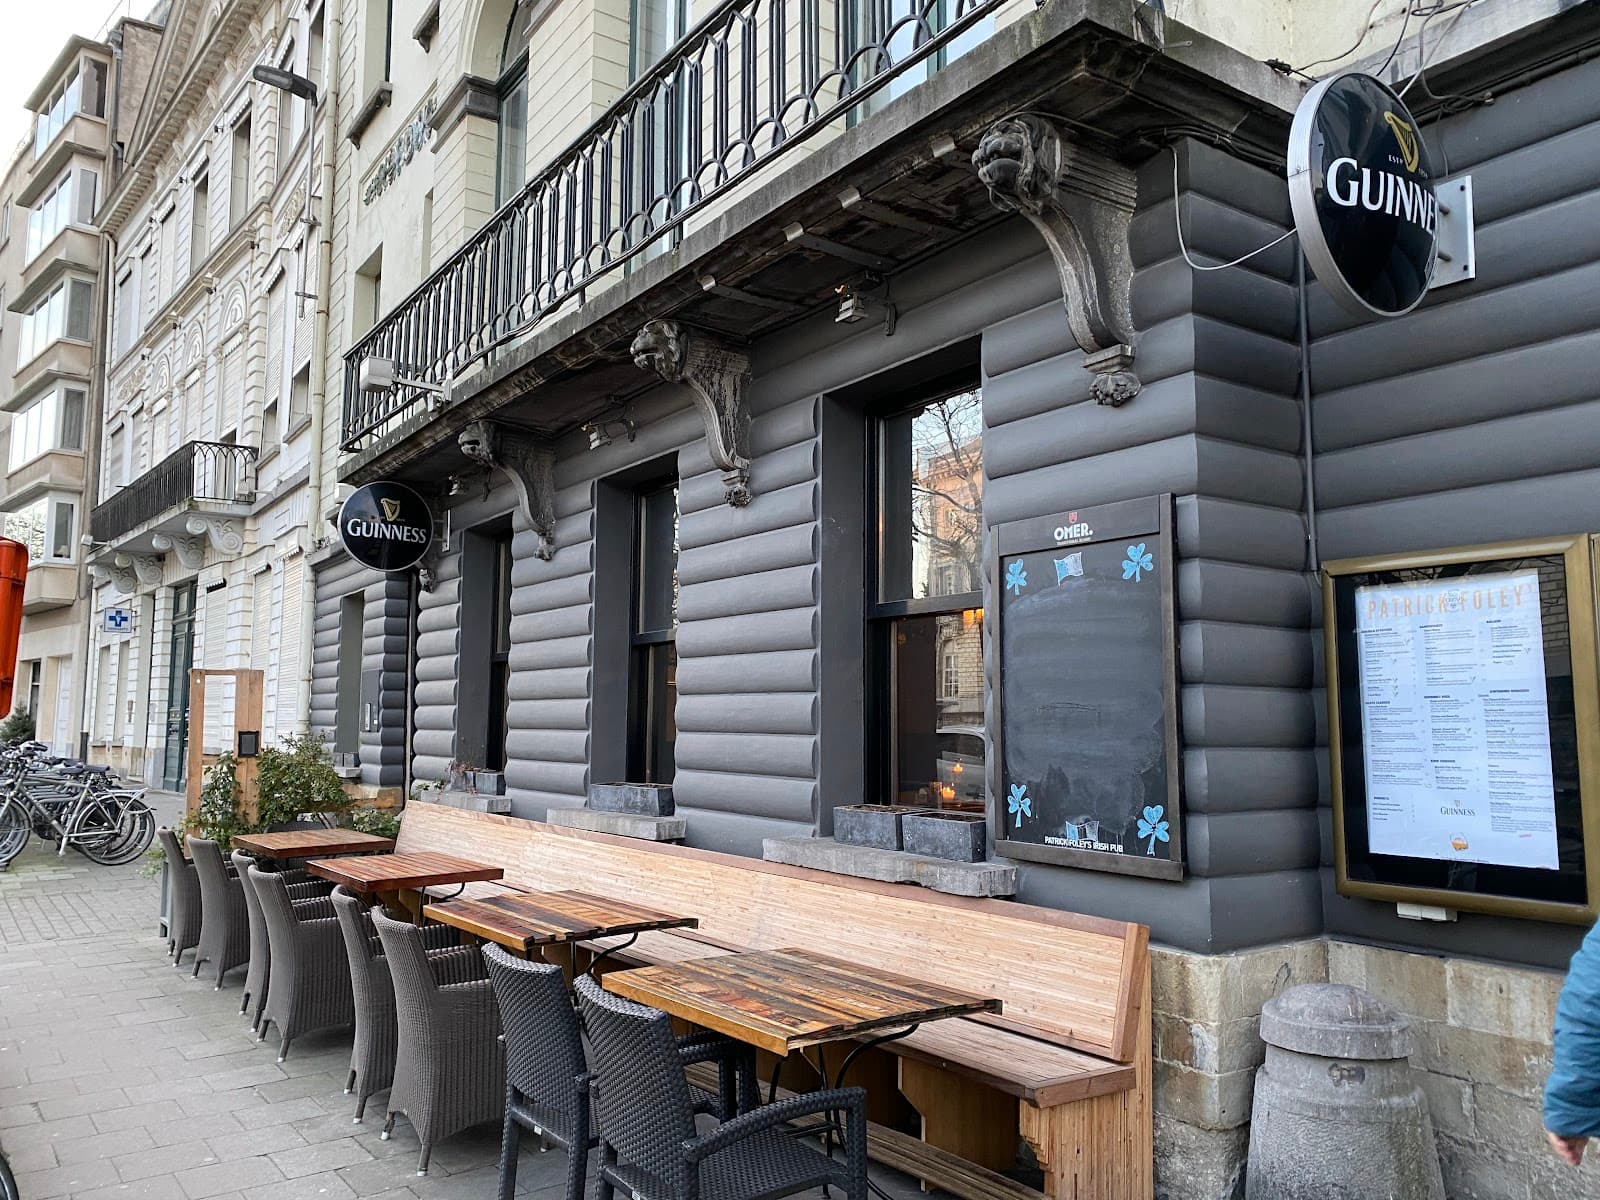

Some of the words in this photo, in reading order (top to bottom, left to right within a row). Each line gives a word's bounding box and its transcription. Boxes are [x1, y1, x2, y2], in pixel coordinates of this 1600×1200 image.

[1326, 157, 1436, 236] GUINNE
[347, 518, 427, 544] GUINNESS
[1367, 592, 1449, 620] PATRICK
[1440, 806, 1476, 817] GUINNESS
[1044, 835, 1068, 847] PATRICK
[1092, 841, 1109, 851] IRISH
[1110, 843, 1124, 853] PUB
